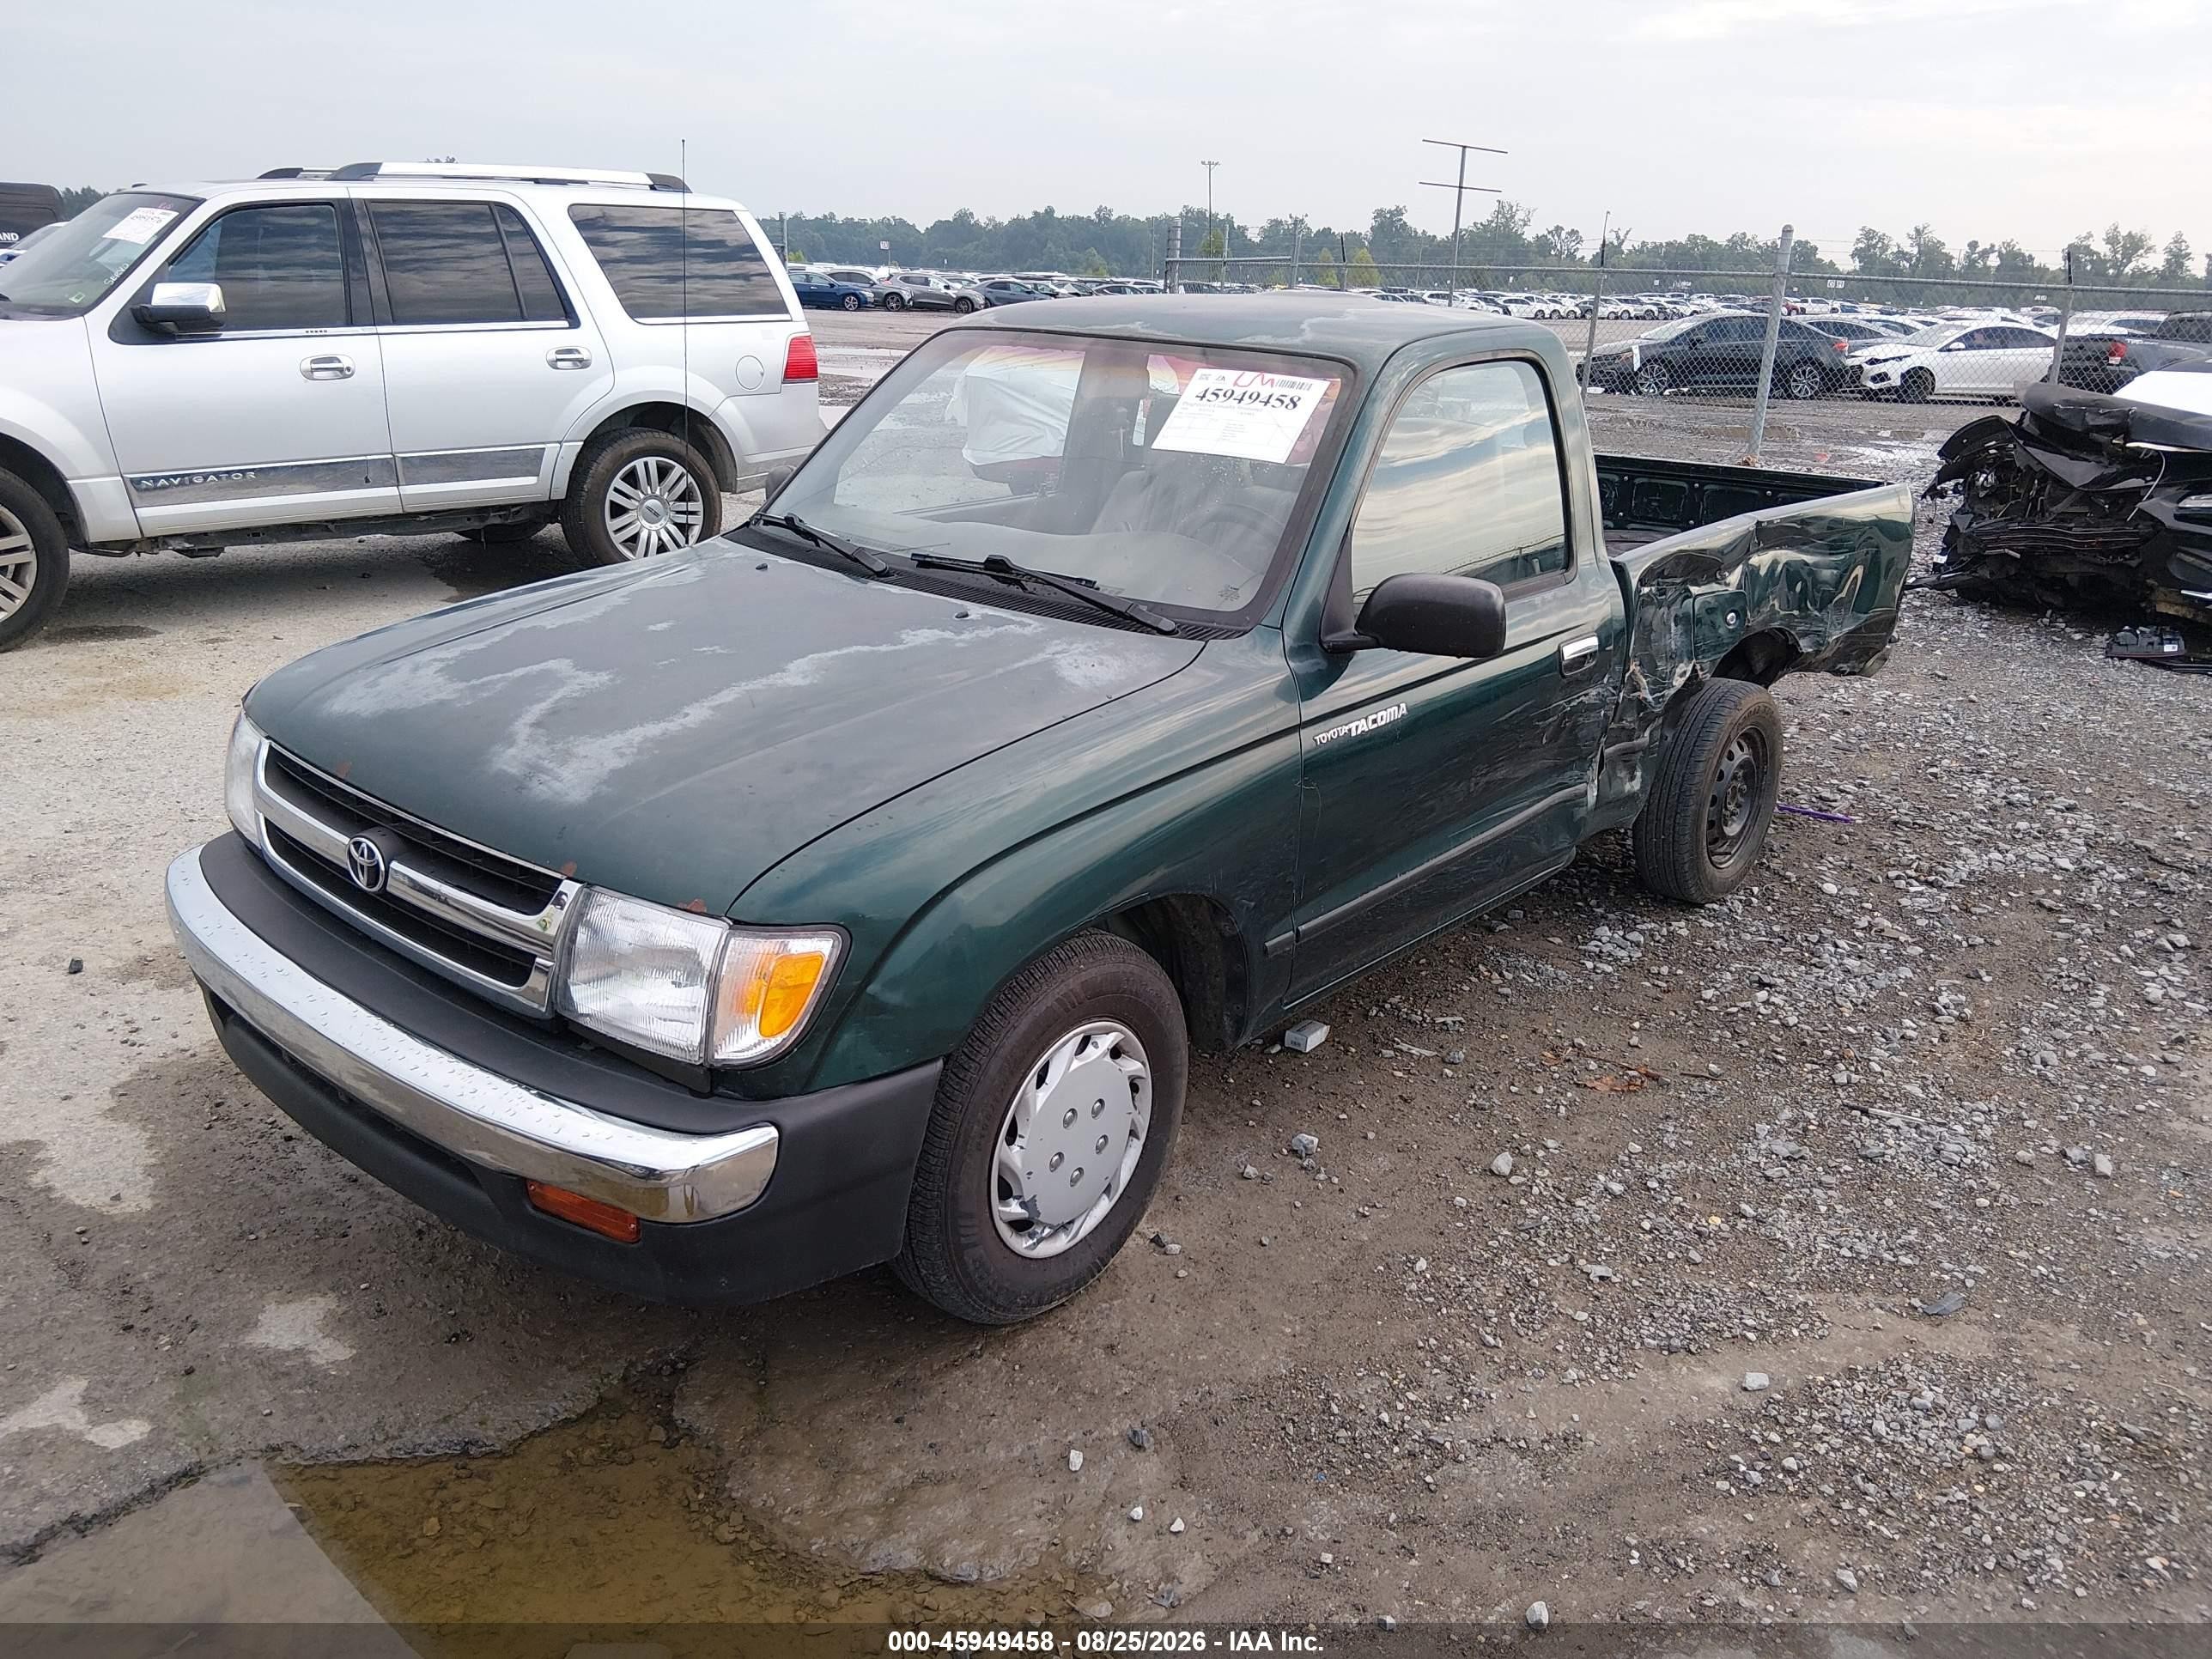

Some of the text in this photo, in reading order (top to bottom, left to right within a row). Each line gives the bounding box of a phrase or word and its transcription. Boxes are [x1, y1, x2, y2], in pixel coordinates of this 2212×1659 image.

[1194, 386, 1302, 410] 45949458
[140, 471, 257, 489] NAVIGATOR
[1313, 702, 1408, 745] TOYOTA TACOMA
